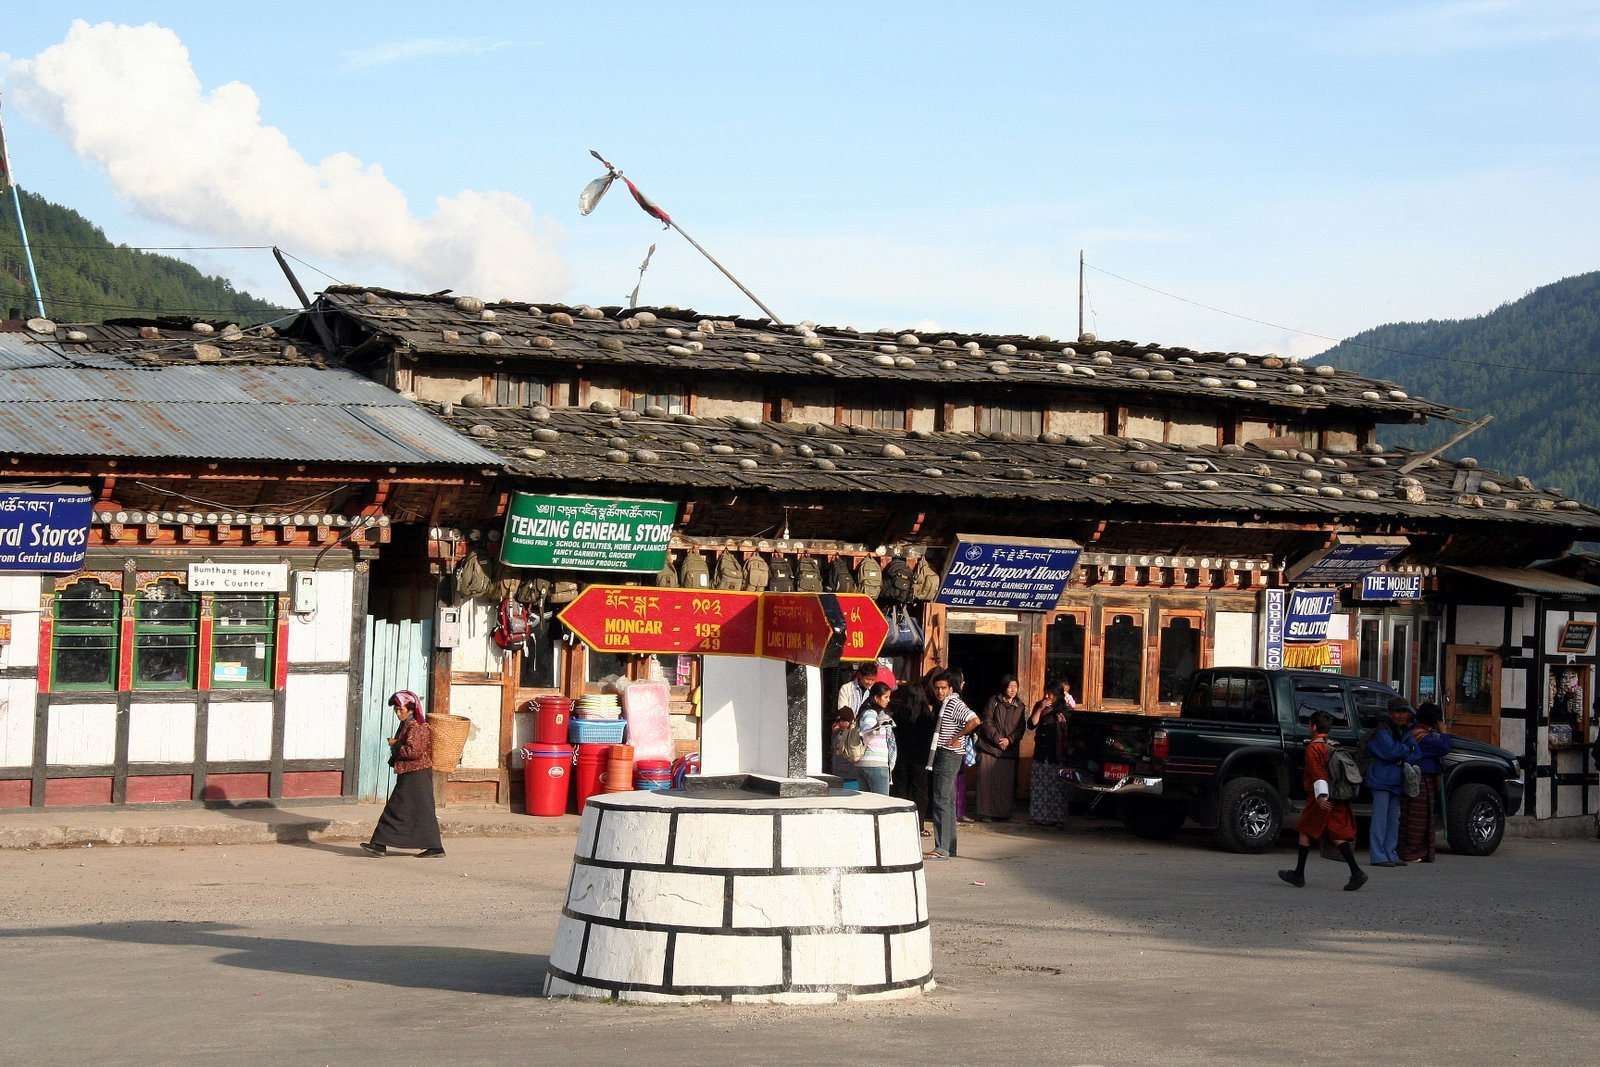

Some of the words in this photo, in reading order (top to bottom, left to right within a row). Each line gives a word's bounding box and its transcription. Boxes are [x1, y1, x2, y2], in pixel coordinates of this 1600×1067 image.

[30, 523, 87, 546] Stores
[511, 514, 570, 538] TENZING
[572, 521, 632, 542] GENERAL
[512, 537, 534, 546] RANGING
[555, 540, 580, 548] SCHOOL
[582, 541, 613, 551] UTILITIES,
[614, 543, 632, 551] HOME
[632, 543, 668, 551] APPLIANCES
[18, 551, 52, 563] Central
[53, 551, 85, 563] Bhutan
[573, 550, 608, 559] GARMENTS,
[608, 551, 637, 559] GROCERY
[560, 558, 595, 566] BUMTHANG
[595, 560, 629, 568] PRODUCTS.
[194, 566, 237, 576] Bumthang
[243, 568, 271, 577] Honey
[949, 561, 990, 580] Dorji
[988, 563, 1036, 582] Import
[1032, 566, 1070, 580] House
[194, 579, 215, 587] Sale
[224, 579, 264, 587] Counter
[953, 579, 967, 587] ALL
[969, 580, 990, 588] TYPES
[991, 581, 1001, 589] OF
[1001, 582, 1034, 590] GARMENT
[1032, 583, 1054, 591] ITEMS
[1367, 576, 1385, 591] THE
[1387, 576, 1420, 591] MOBILE
[941, 587, 976, 597] CHAMKHAR
[996, 591, 1030, 600] BUMTHANG
[951, 597, 975, 605] SALE
[985, 599, 1010, 607] SALE
[1269, 592, 1282, 643] MOBILE
[604, 618, 663, 634] MONGAR
[694, 623, 721, 638] 193
[604, 634, 631, 646] URA
[699, 638, 721, 650] 49
[852, 631, 864, 648] 68
